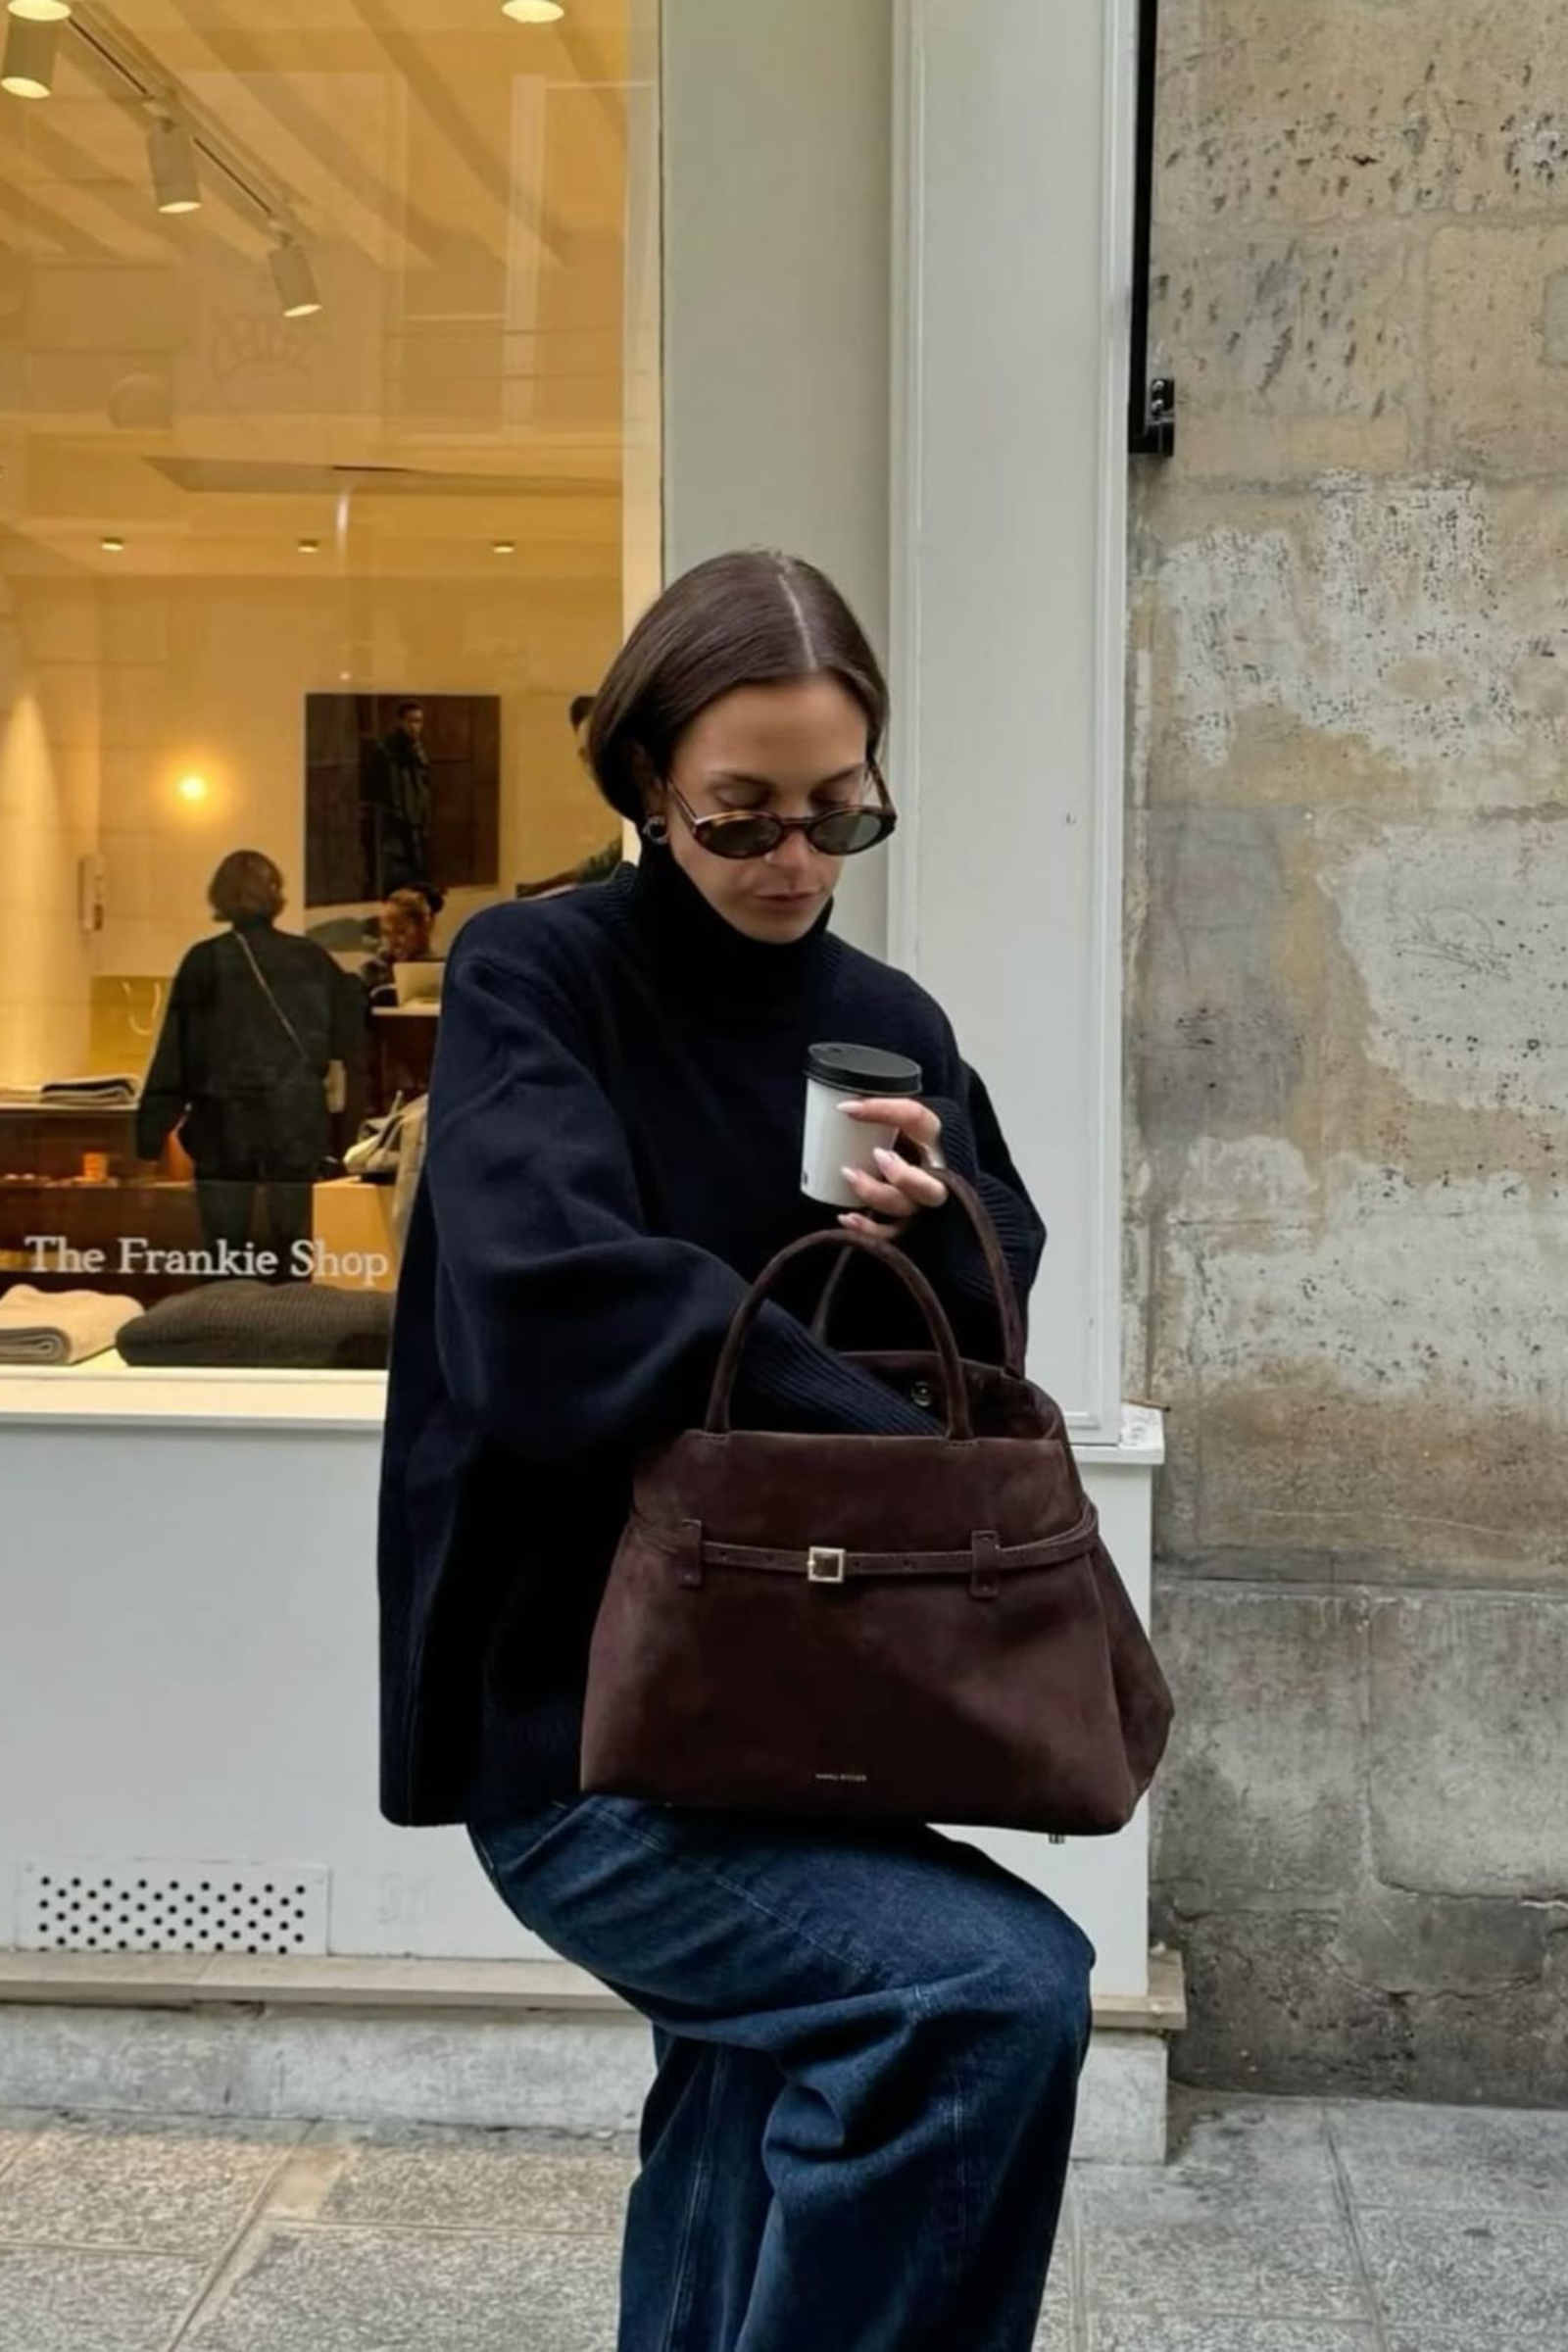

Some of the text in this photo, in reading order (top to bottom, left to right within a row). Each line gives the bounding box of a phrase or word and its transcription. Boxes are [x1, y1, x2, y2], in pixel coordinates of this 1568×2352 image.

[24, 1235, 389, 1288] The Frankie Shop
